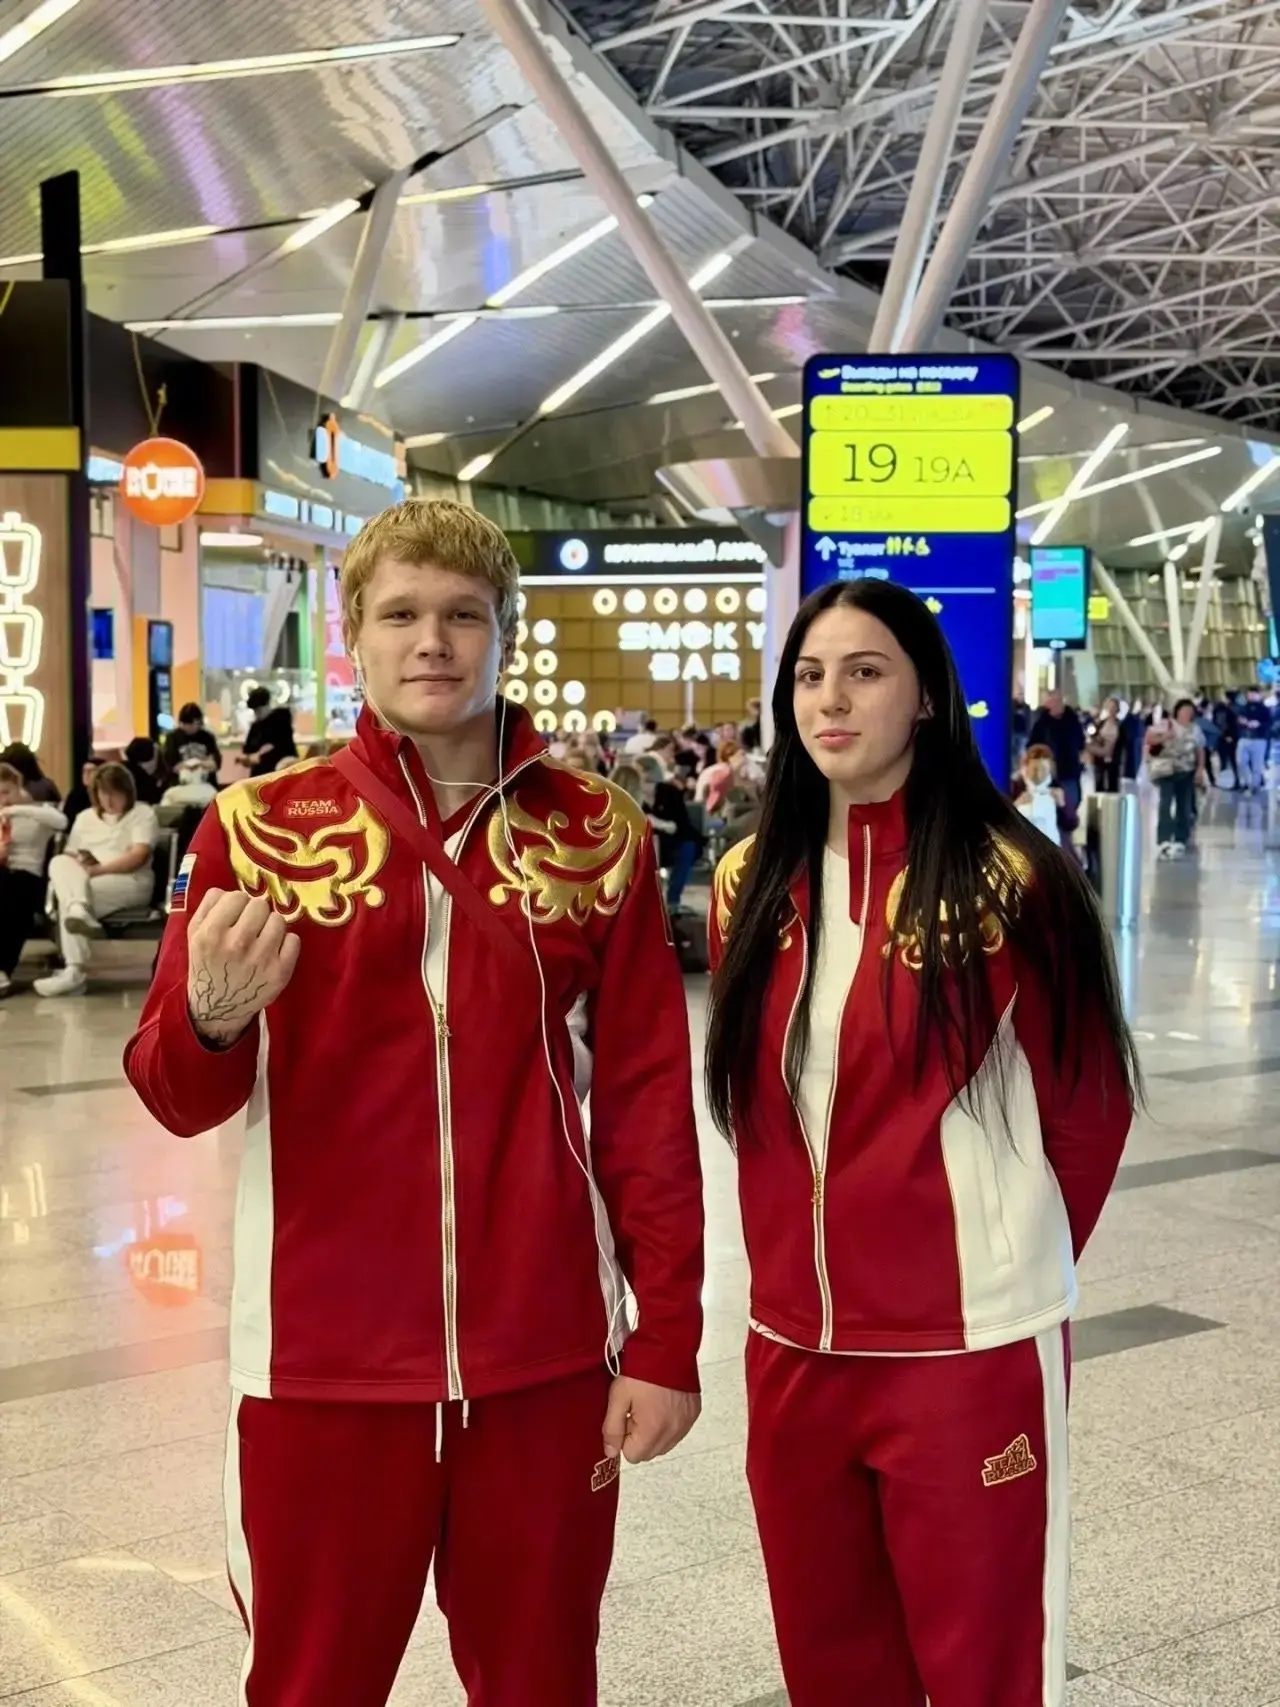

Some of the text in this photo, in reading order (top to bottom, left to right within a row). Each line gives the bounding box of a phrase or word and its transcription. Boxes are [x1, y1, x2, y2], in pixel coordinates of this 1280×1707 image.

[843, 443, 976, 483] 19 19A
[293, 800, 332, 808] TEAM
[287, 806, 339, 816] RUSSIA
